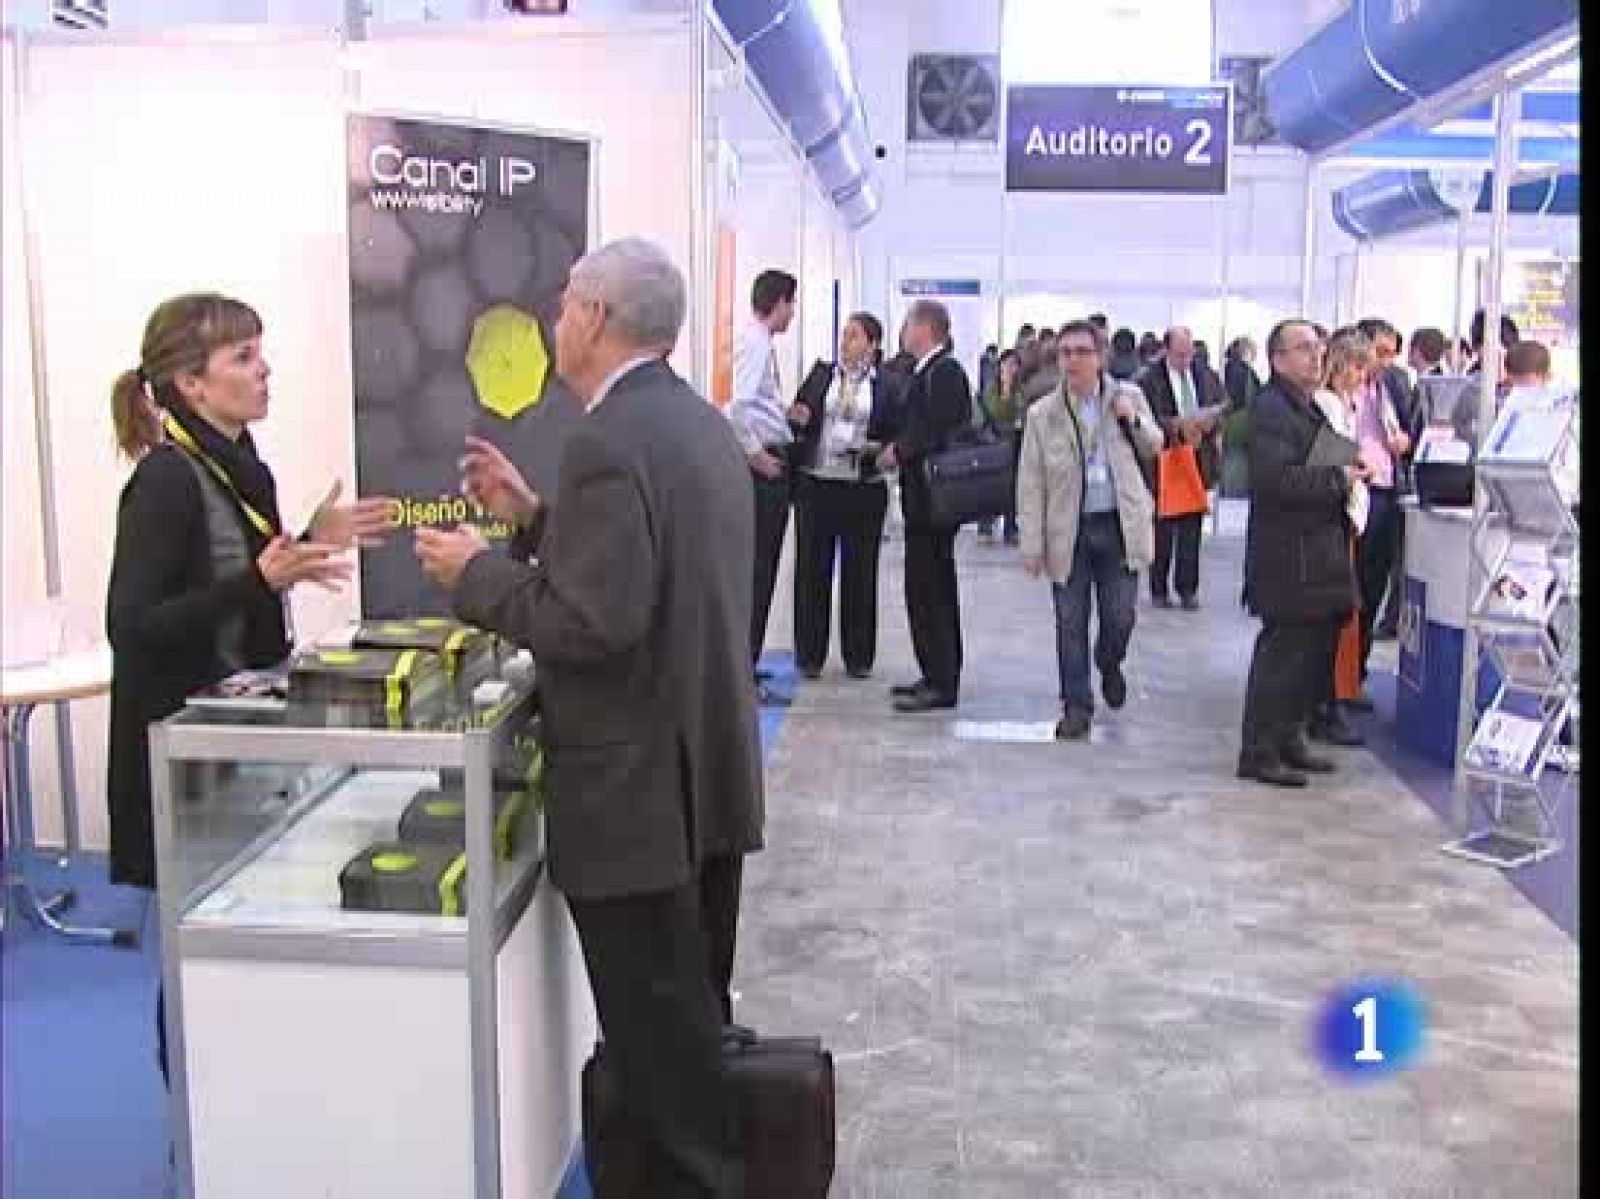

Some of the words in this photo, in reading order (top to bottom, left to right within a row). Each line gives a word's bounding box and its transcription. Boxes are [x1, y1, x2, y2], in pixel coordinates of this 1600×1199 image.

[1025, 124, 1173, 157] Auditorio
[1184, 118, 1212, 165] 2
[371, 145, 487, 192] Canal
[499, 156, 536, 195] IP
[387, 494, 466, 525] Diseño
